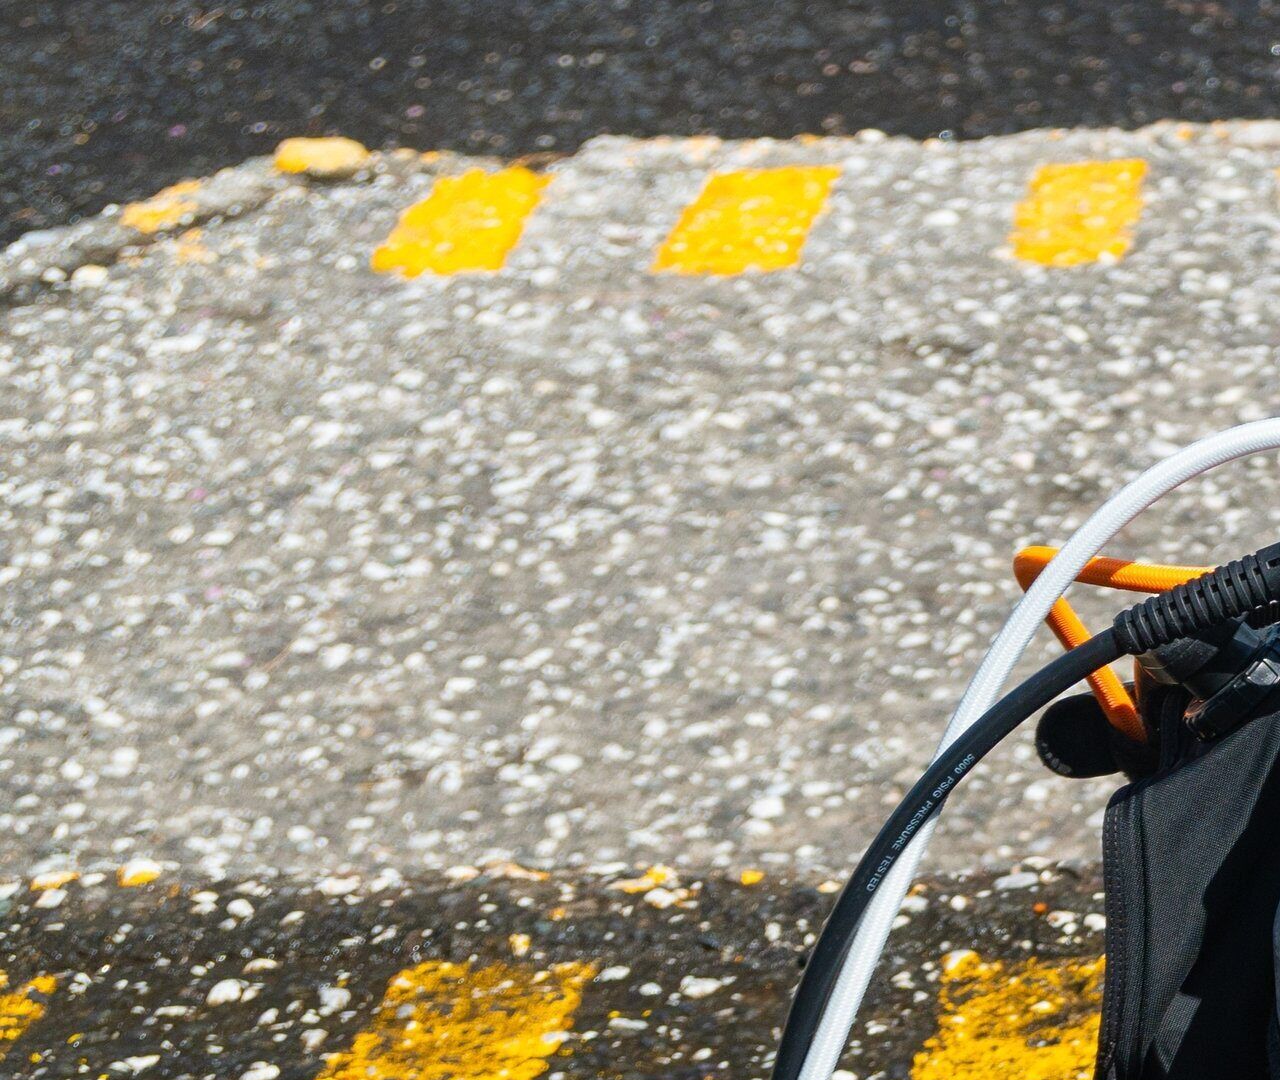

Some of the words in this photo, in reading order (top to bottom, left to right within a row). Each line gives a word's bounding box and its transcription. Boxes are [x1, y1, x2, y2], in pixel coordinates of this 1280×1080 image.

[953, 753, 976, 775] 5000
[932, 775, 955, 799] PSIG
[891, 800, 934, 852] PRESSURE
[866, 855, 895, 892] TESTED
